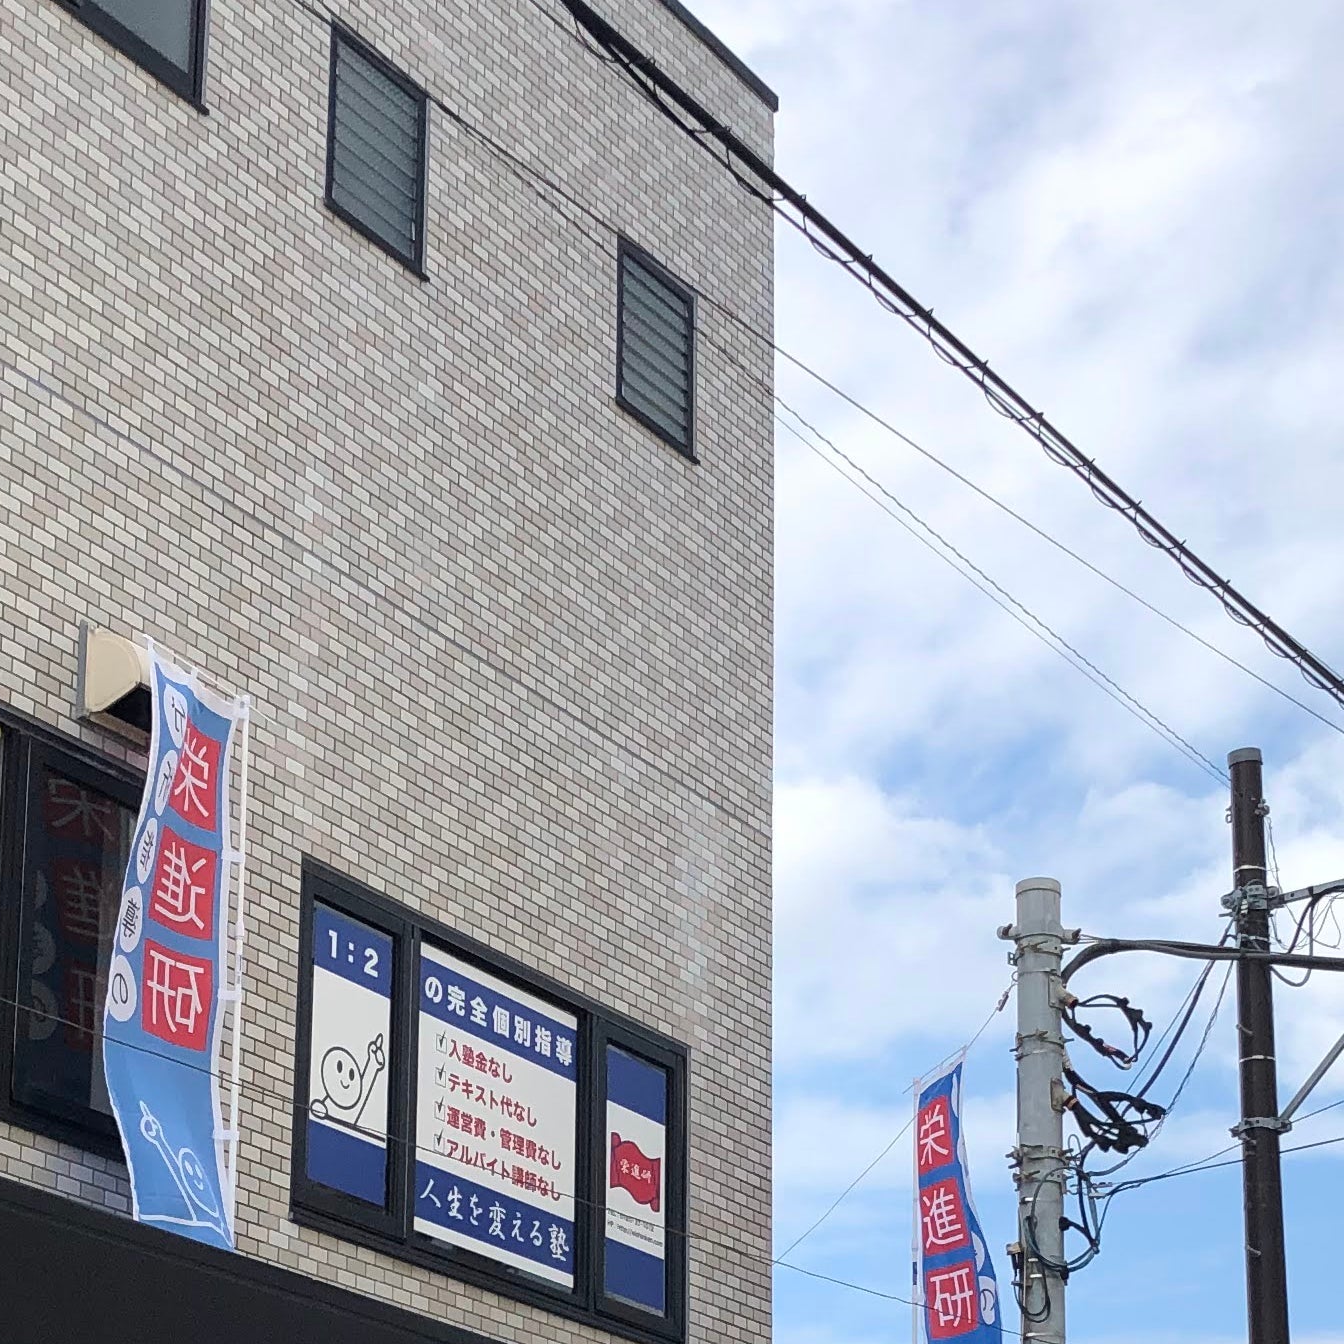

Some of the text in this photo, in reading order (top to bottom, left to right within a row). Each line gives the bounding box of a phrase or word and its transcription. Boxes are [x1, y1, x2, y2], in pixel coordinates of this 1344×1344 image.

[424, 976, 573, 1067] の完全個別指導
[448, 1038, 513, 1084] 入塾金なし
[447, 1073, 538, 1127] テキスト代なし
[446, 1105, 562, 1171] 運営費・管理費なし
[446, 1138, 562, 1202] アルバイト講師なし
[419, 1178, 570, 1262] 人生を変える塾
[919, 1103, 974, 1328] 栄進研
